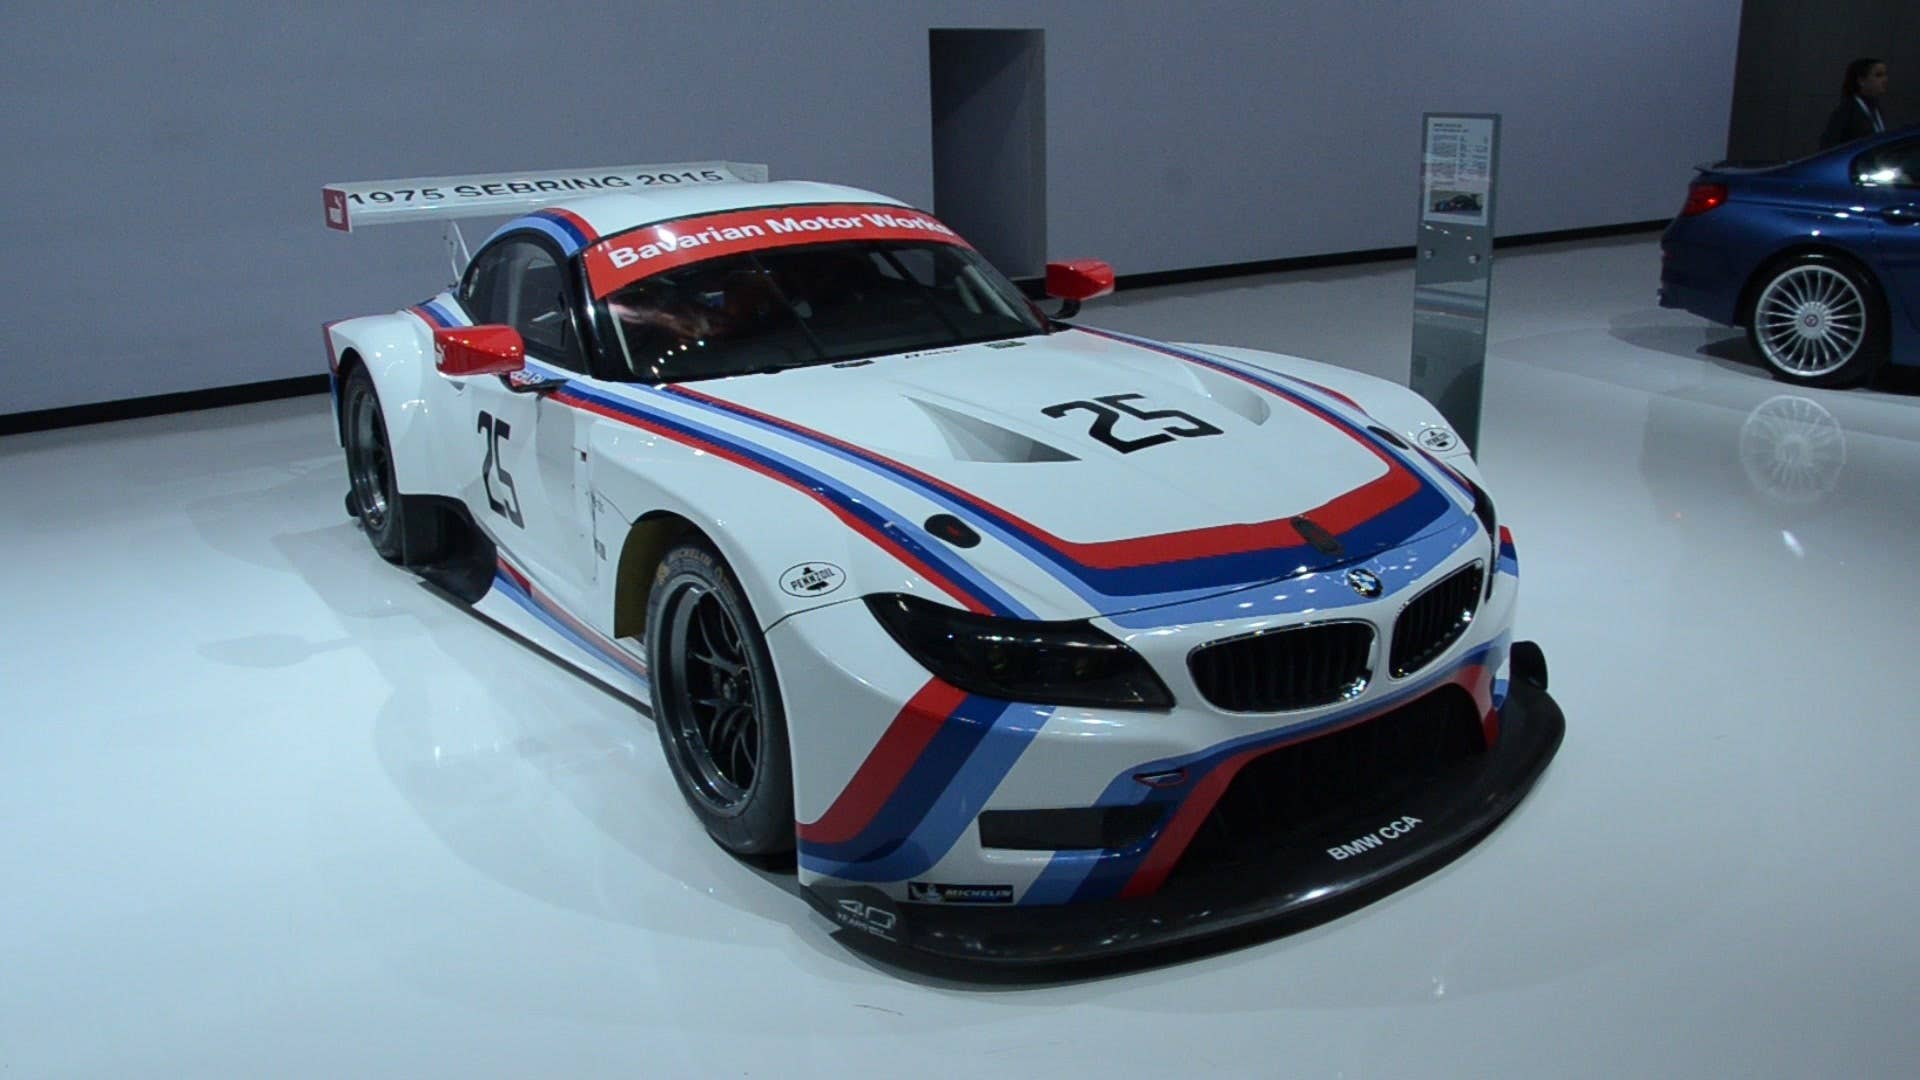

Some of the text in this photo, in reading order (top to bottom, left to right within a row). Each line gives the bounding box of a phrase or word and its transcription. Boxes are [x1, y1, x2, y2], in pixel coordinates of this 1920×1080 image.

[348, 170, 723, 205] 1975 SEBRING 2015
[608, 223, 765, 269] Bavarian
[764, 215, 864, 234] Motor
[1041, 393, 1224, 455] 25
[477, 410, 525, 530] 25
[1326, 815, 1423, 861] BMW CCA
[838, 899, 897, 929] 40
